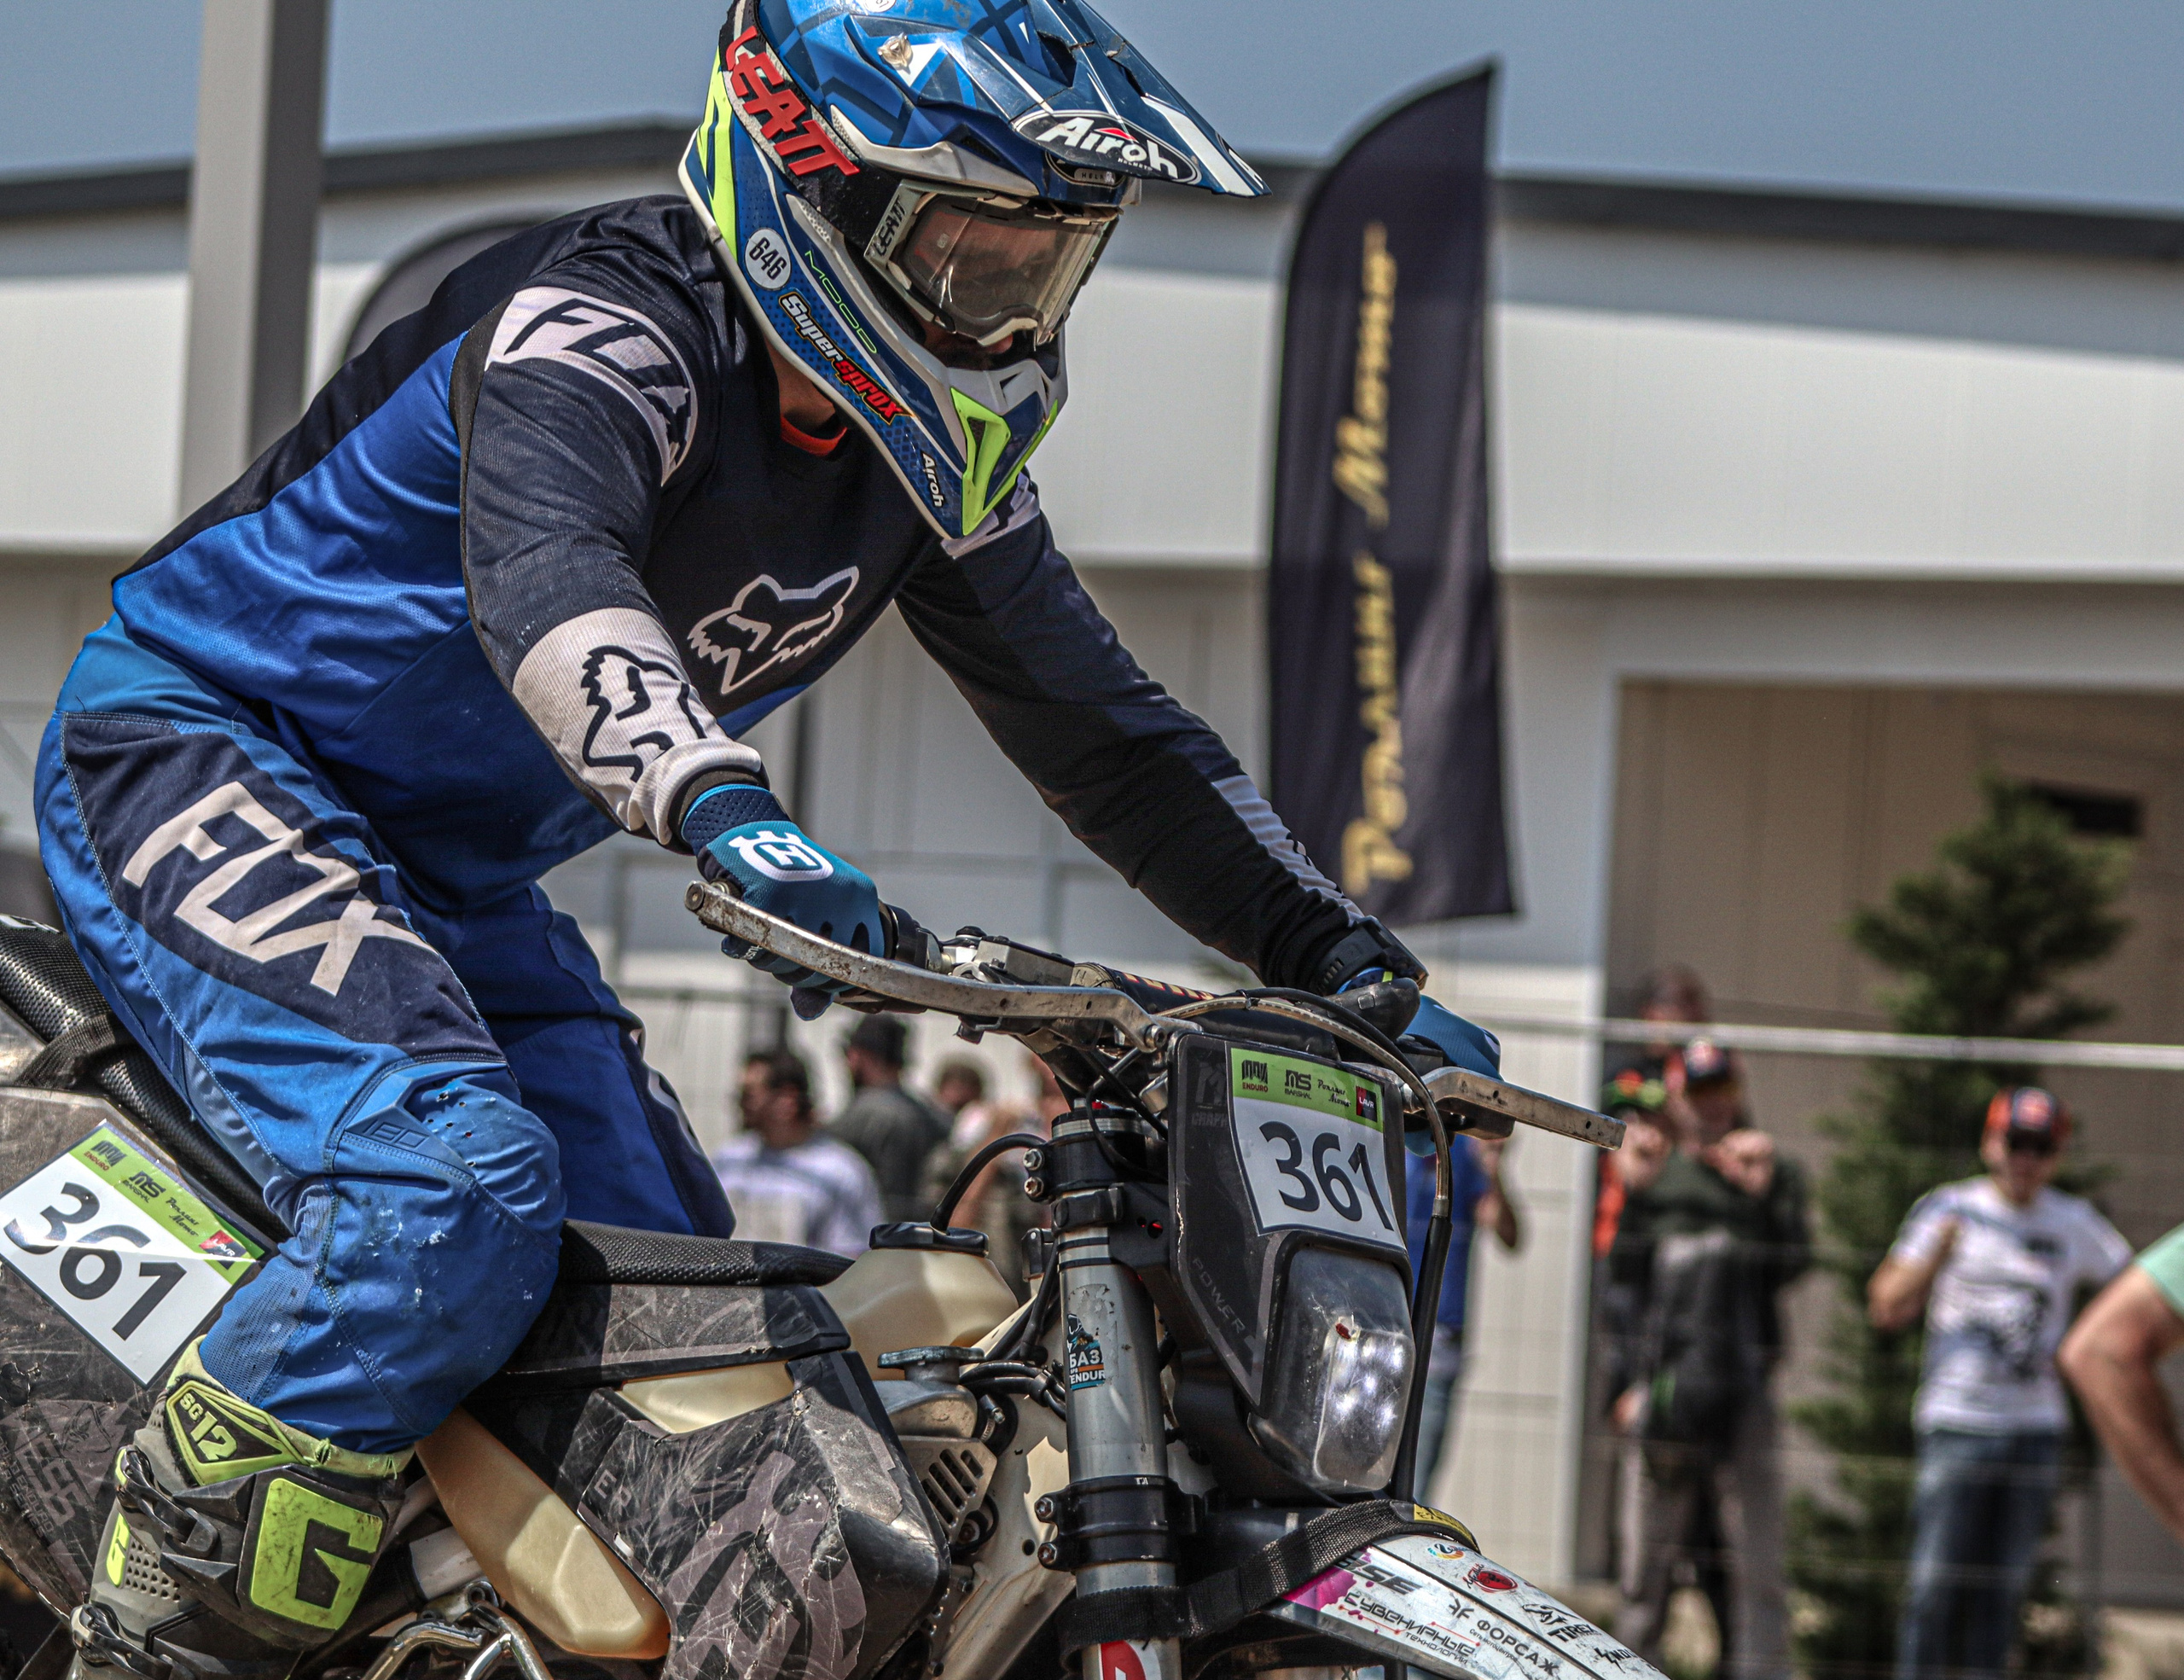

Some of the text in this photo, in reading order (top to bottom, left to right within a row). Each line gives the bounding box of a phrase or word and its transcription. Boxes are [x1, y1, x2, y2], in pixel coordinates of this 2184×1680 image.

[725, 26, 860, 176] LEATT
[1035, 117, 1178, 179] Airoh
[874, 195, 907, 256] LEATT
[749, 236, 787, 279] 646
[921, 452, 945, 508] Airoh
[122, 780, 439, 997] FOX
[1242, 1082, 1269, 1093] ENDURO
[1358, 1096, 1374, 1108] LAVR
[84, 1151, 110, 1171] ENDURO
[1259, 1120, 1395, 1231] 361
[3, 1181, 188, 1341] 361
[212, 1238, 235, 1257] LAVR
[1069, 1349, 1102, 1368] БАЗ
[1477, 1619, 1560, 1677] ФОРСАЖ
